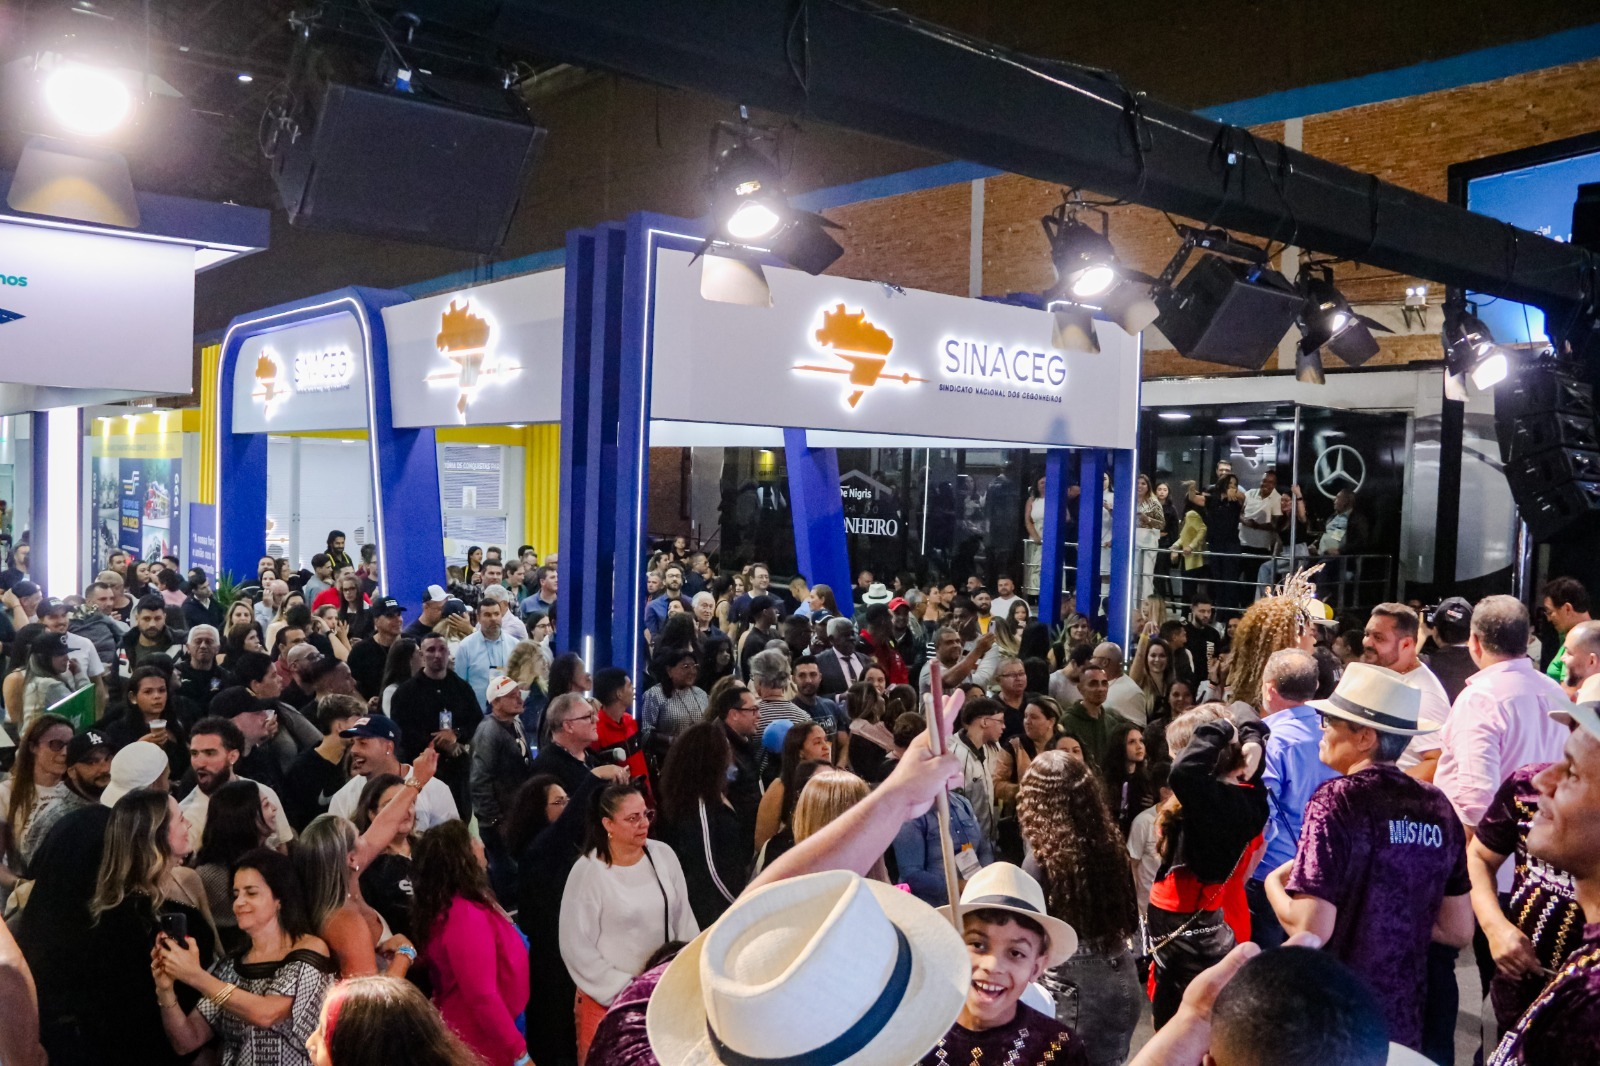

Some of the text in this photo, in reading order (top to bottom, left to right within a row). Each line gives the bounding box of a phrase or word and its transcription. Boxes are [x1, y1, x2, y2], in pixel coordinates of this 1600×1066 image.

[945, 340, 1066, 386] SINACEG
[939, 383, 1063, 403] SINDICATO NACIONAL DOS CEGONHEIROS
[849, 487, 872, 500] Nigris
[844, 516, 898, 537] NHEIRO
[86, 731, 104, 745] LA
[1389, 815, 1442, 848] MÚSICO
